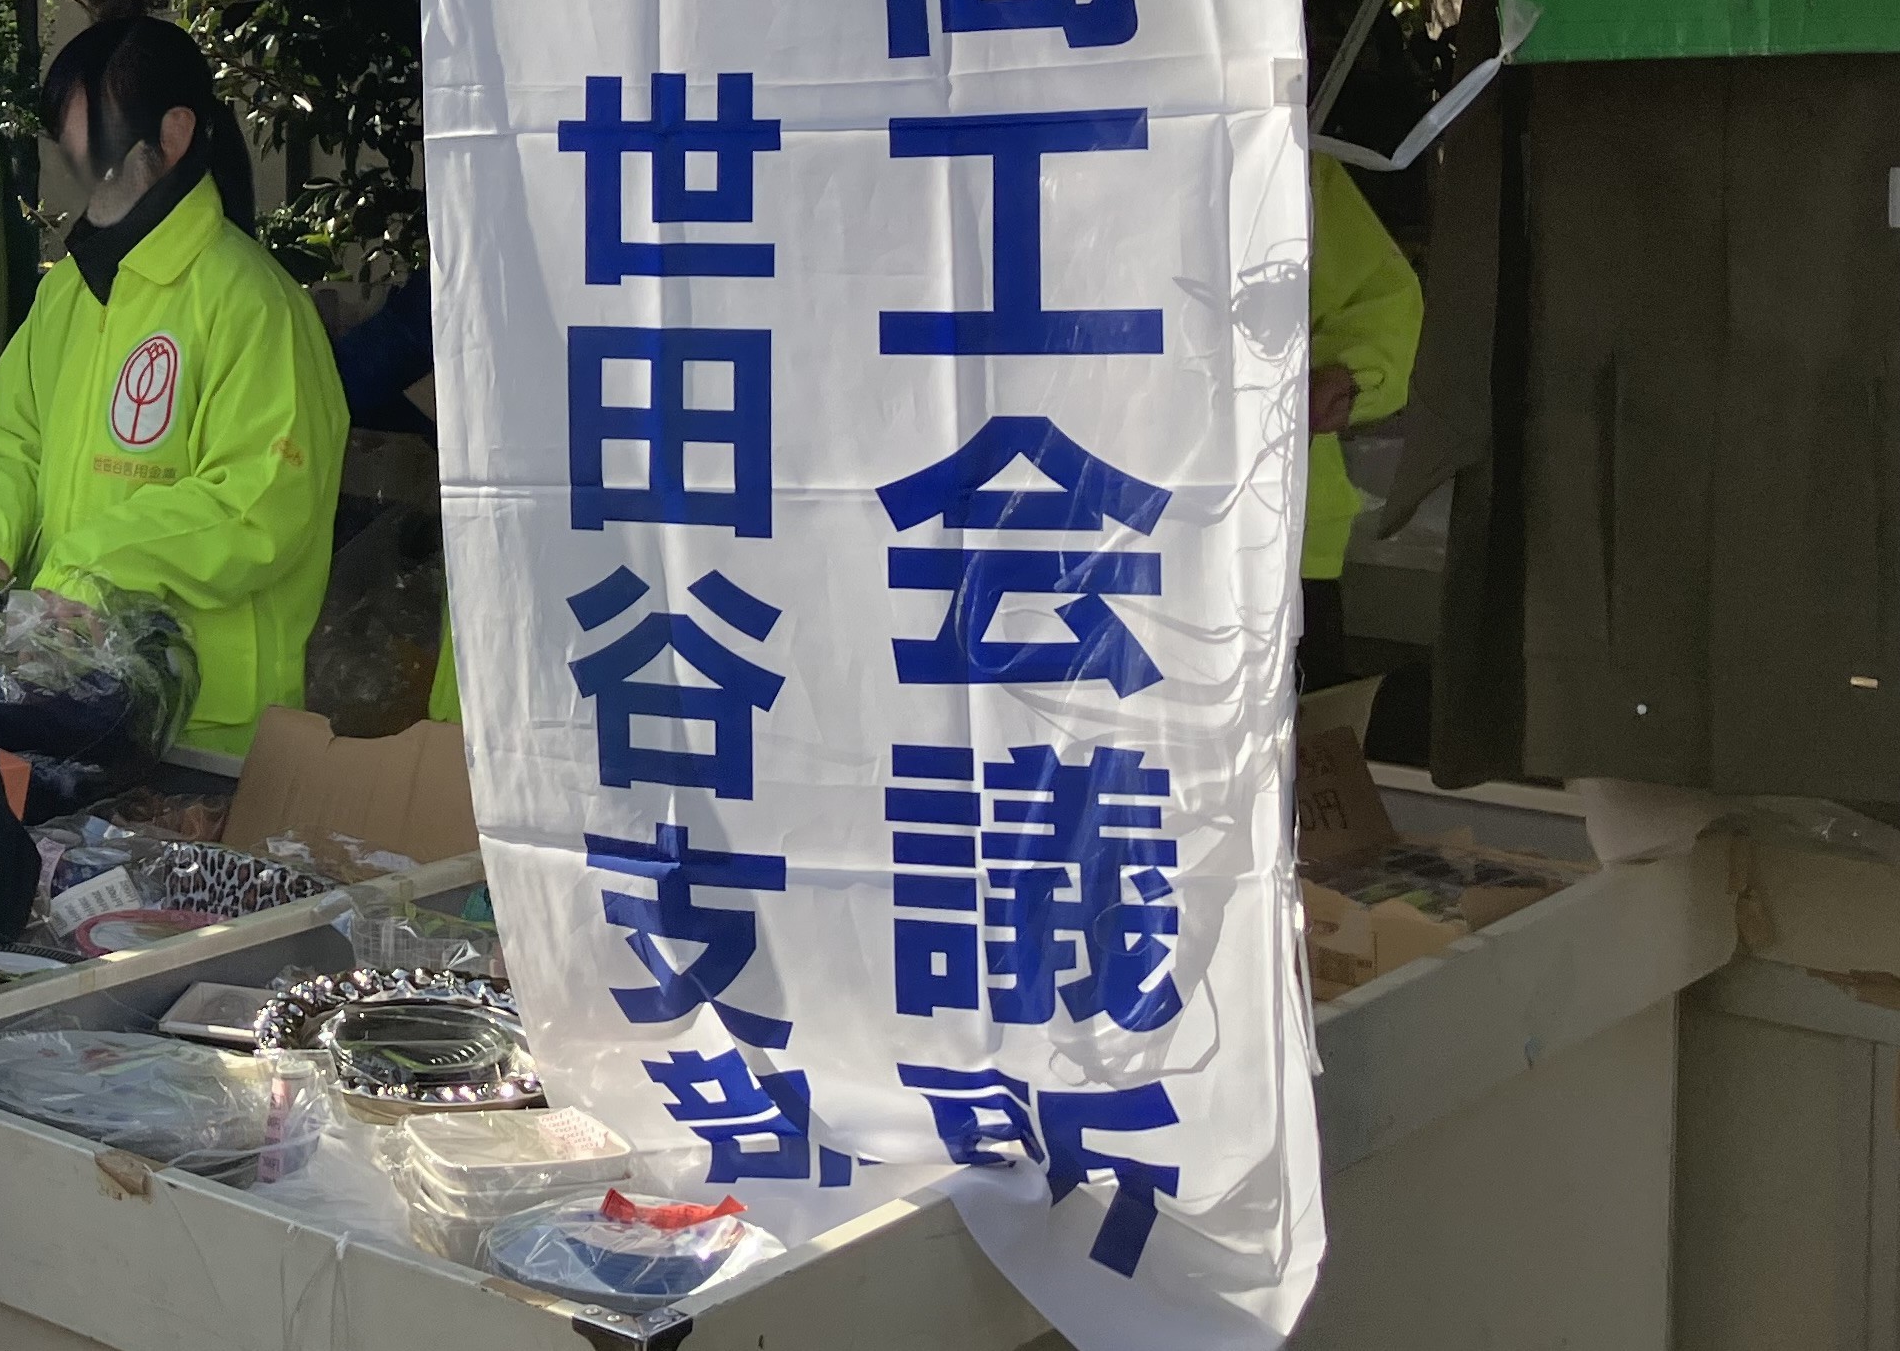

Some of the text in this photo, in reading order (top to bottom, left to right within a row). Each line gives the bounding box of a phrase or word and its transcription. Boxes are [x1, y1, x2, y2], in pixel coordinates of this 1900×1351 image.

[558, 72, 883, 1189] 世田谷支部
